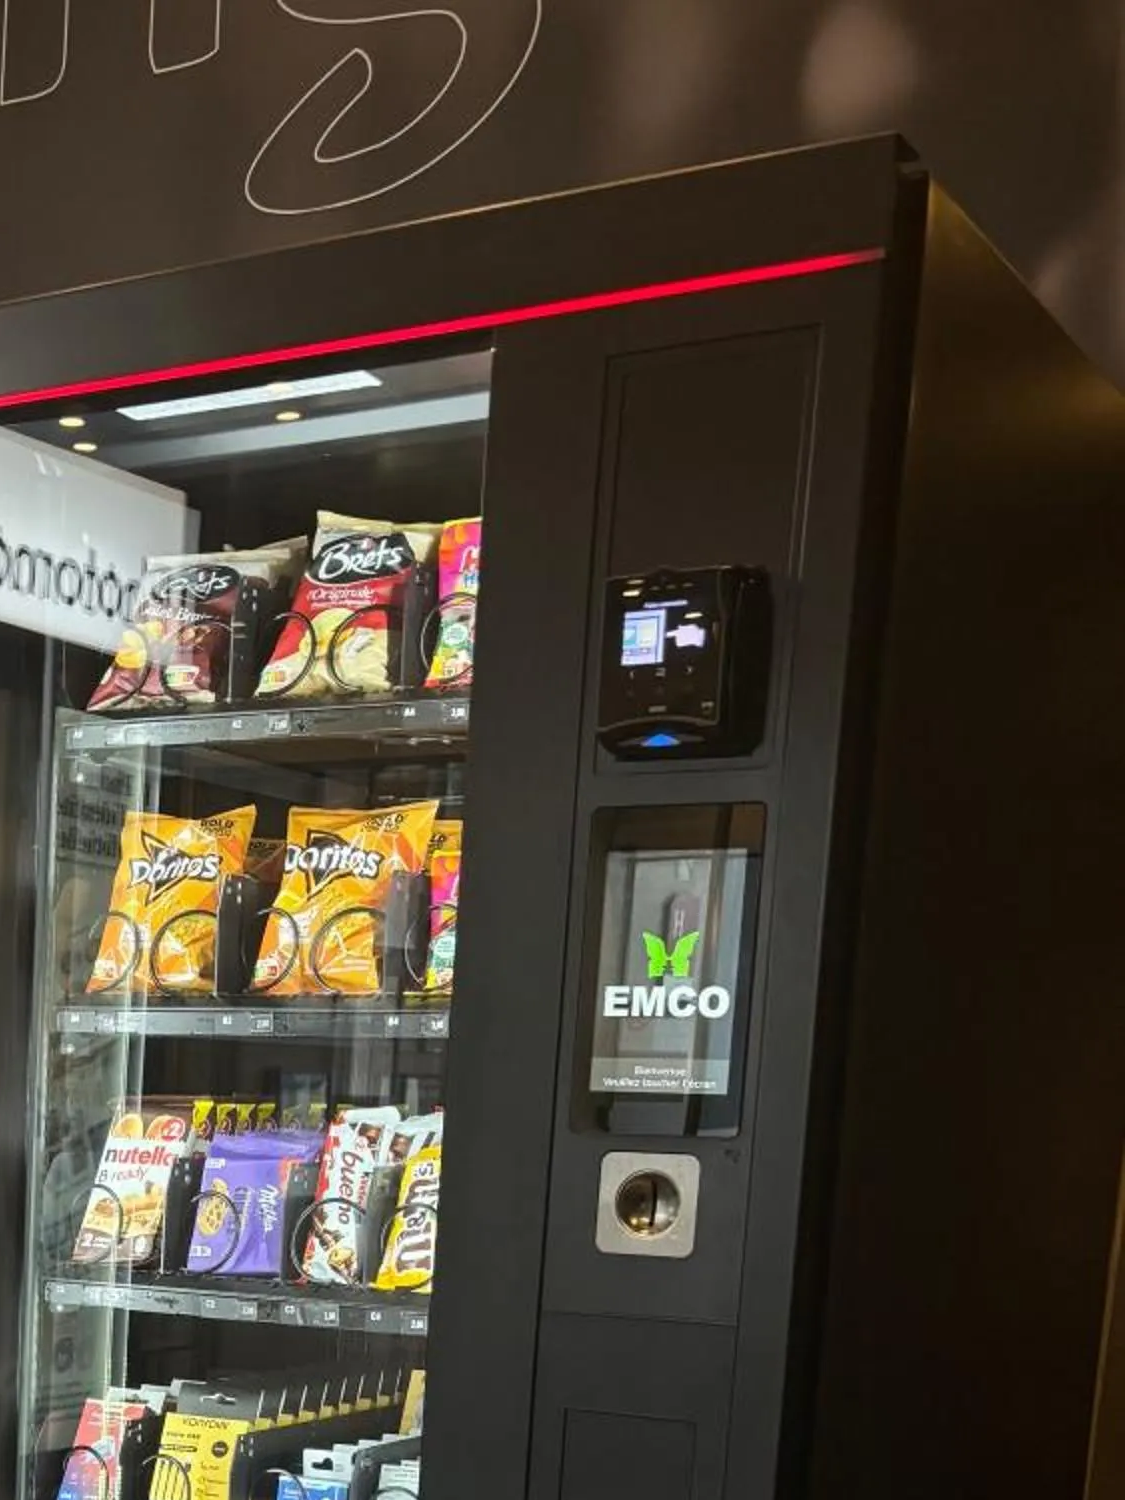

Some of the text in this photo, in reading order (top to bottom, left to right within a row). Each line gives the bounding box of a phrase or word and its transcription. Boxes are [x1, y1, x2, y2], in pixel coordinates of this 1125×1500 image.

[318, 540, 404, 579] Brets
[130, 853, 222, 882] Doritos
[284, 845, 383, 879] Doritos
[602, 984, 730, 1019] EMCO
